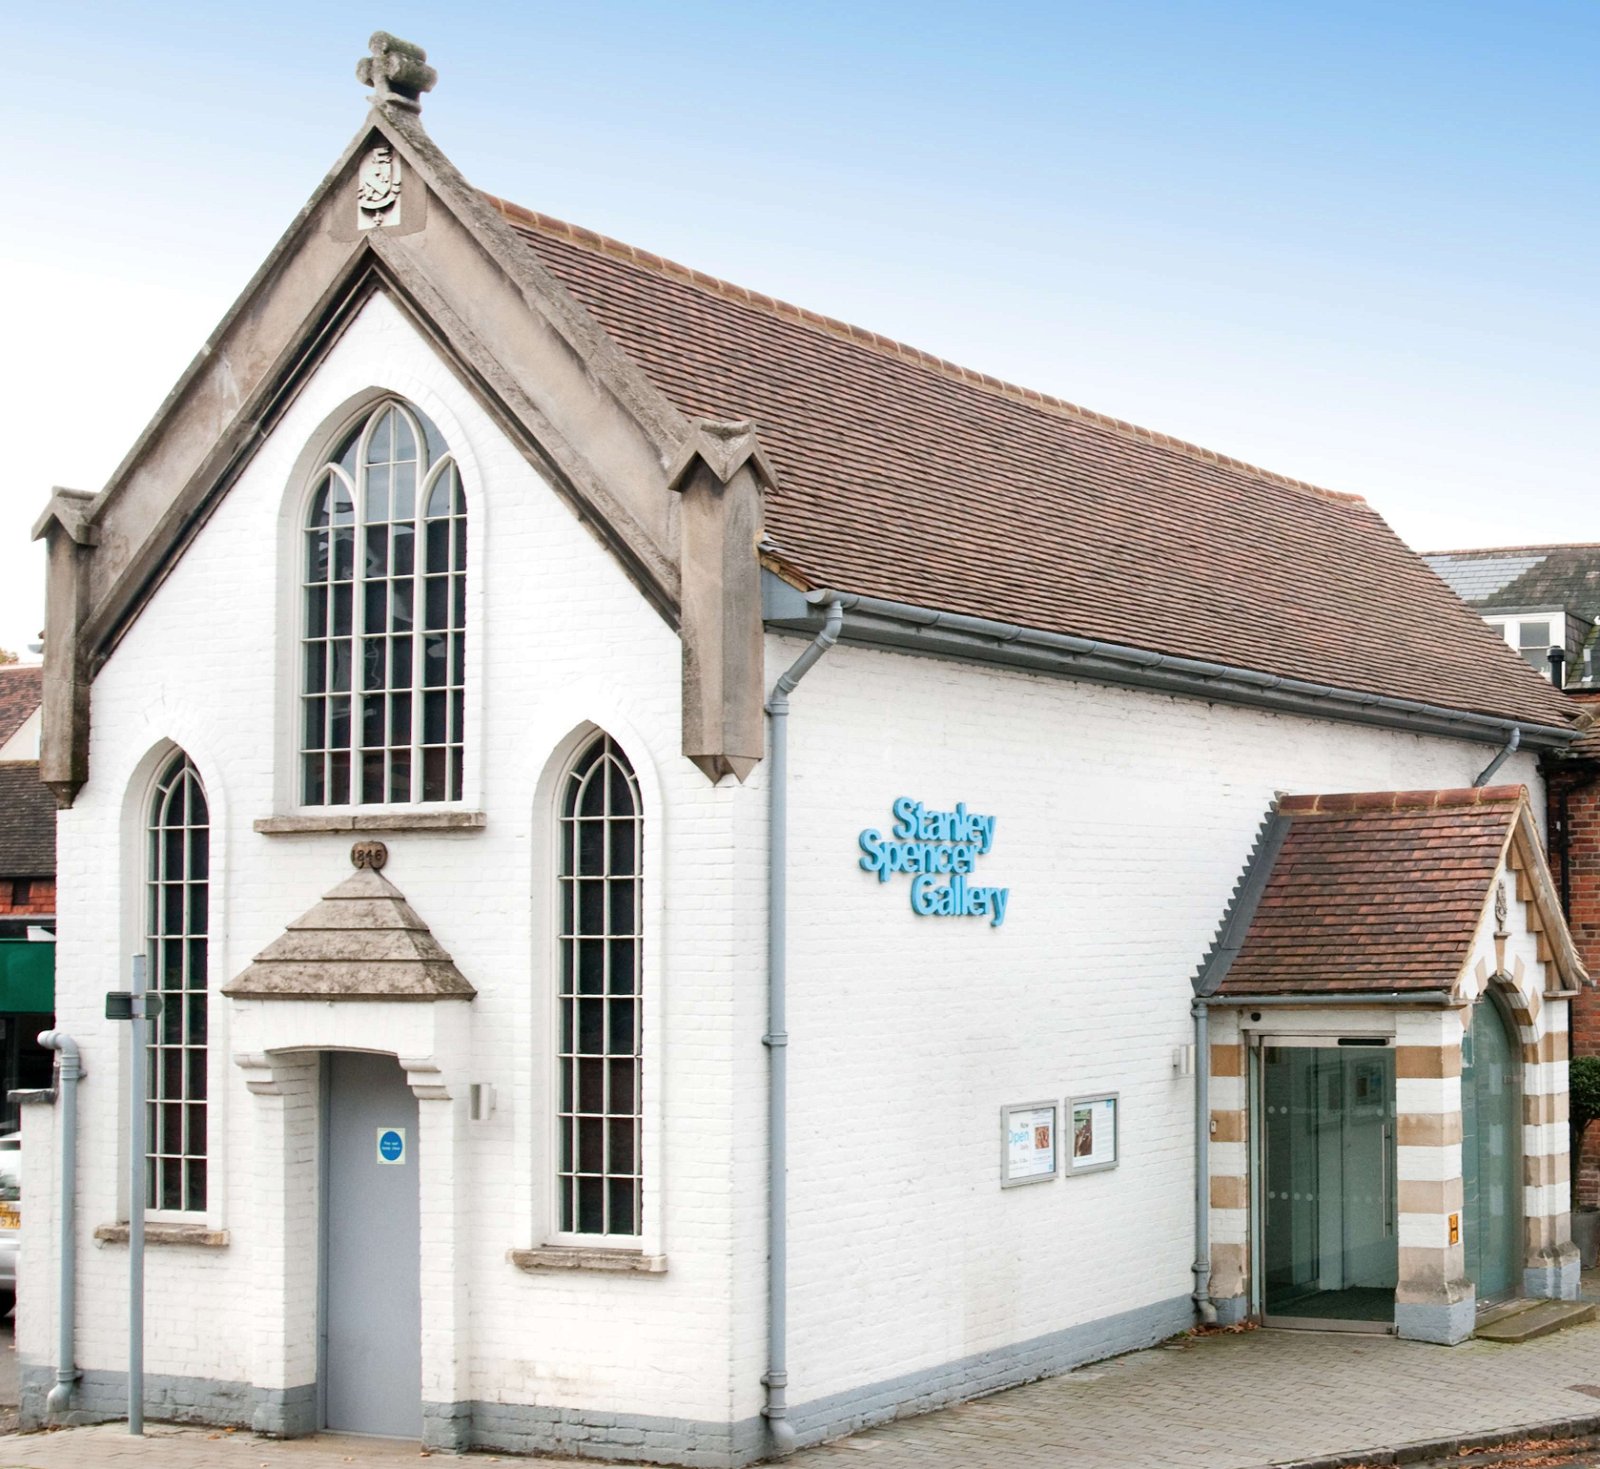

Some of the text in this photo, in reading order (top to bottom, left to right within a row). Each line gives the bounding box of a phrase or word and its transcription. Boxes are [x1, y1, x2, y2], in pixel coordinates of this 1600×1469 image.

[893, 796, 996, 854] Stanley
[859, 828, 977, 882] Spencer
[911, 874, 1009, 927] Gallery
